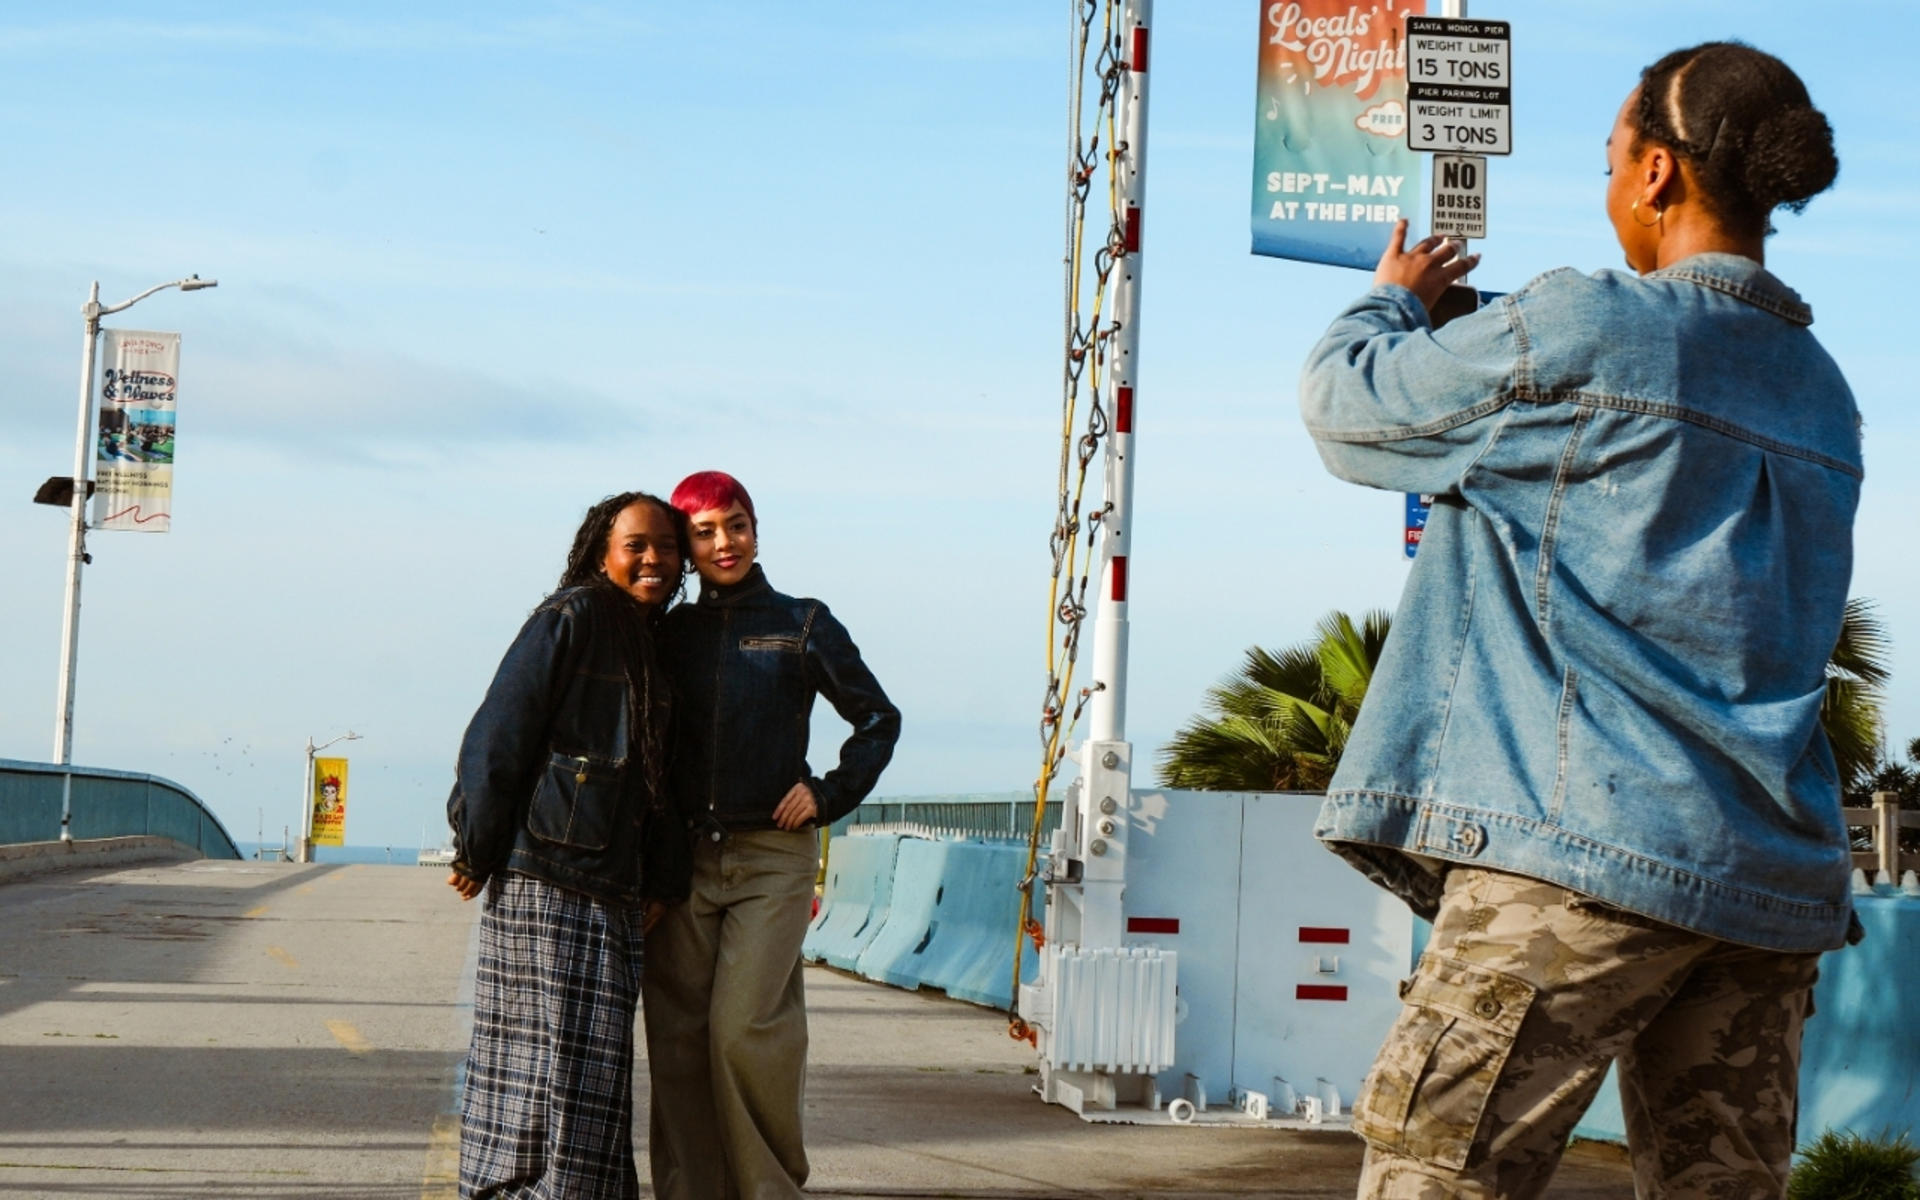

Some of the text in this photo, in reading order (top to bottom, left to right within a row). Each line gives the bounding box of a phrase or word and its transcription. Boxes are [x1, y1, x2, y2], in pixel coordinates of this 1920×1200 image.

[1268, 3, 1378, 52] Locals'
[1413, 22, 1504, 35] SANTA MONICA PIER
[1416, 40, 1500, 54] WEIGHT LIMIT
[1306, 37, 1406, 94] Night
[1417, 58, 1501, 79] 15 TONS
[1418, 88, 1499, 99] PIER PARKING LOT
[1417, 105, 1500, 119] WEIGHT LIMIT
[1422, 124, 1498, 145] 3 TONS
[1443, 162, 1476, 190] NO
[1437, 194, 1482, 209] BUSES
[1269, 201, 1400, 222] AT THE PIER
[1436, 211, 1446, 219] OR
[1456, 223, 1465, 232] 22
[105, 369, 175, 386] Wellness
[104, 383, 175, 401] & Waves
